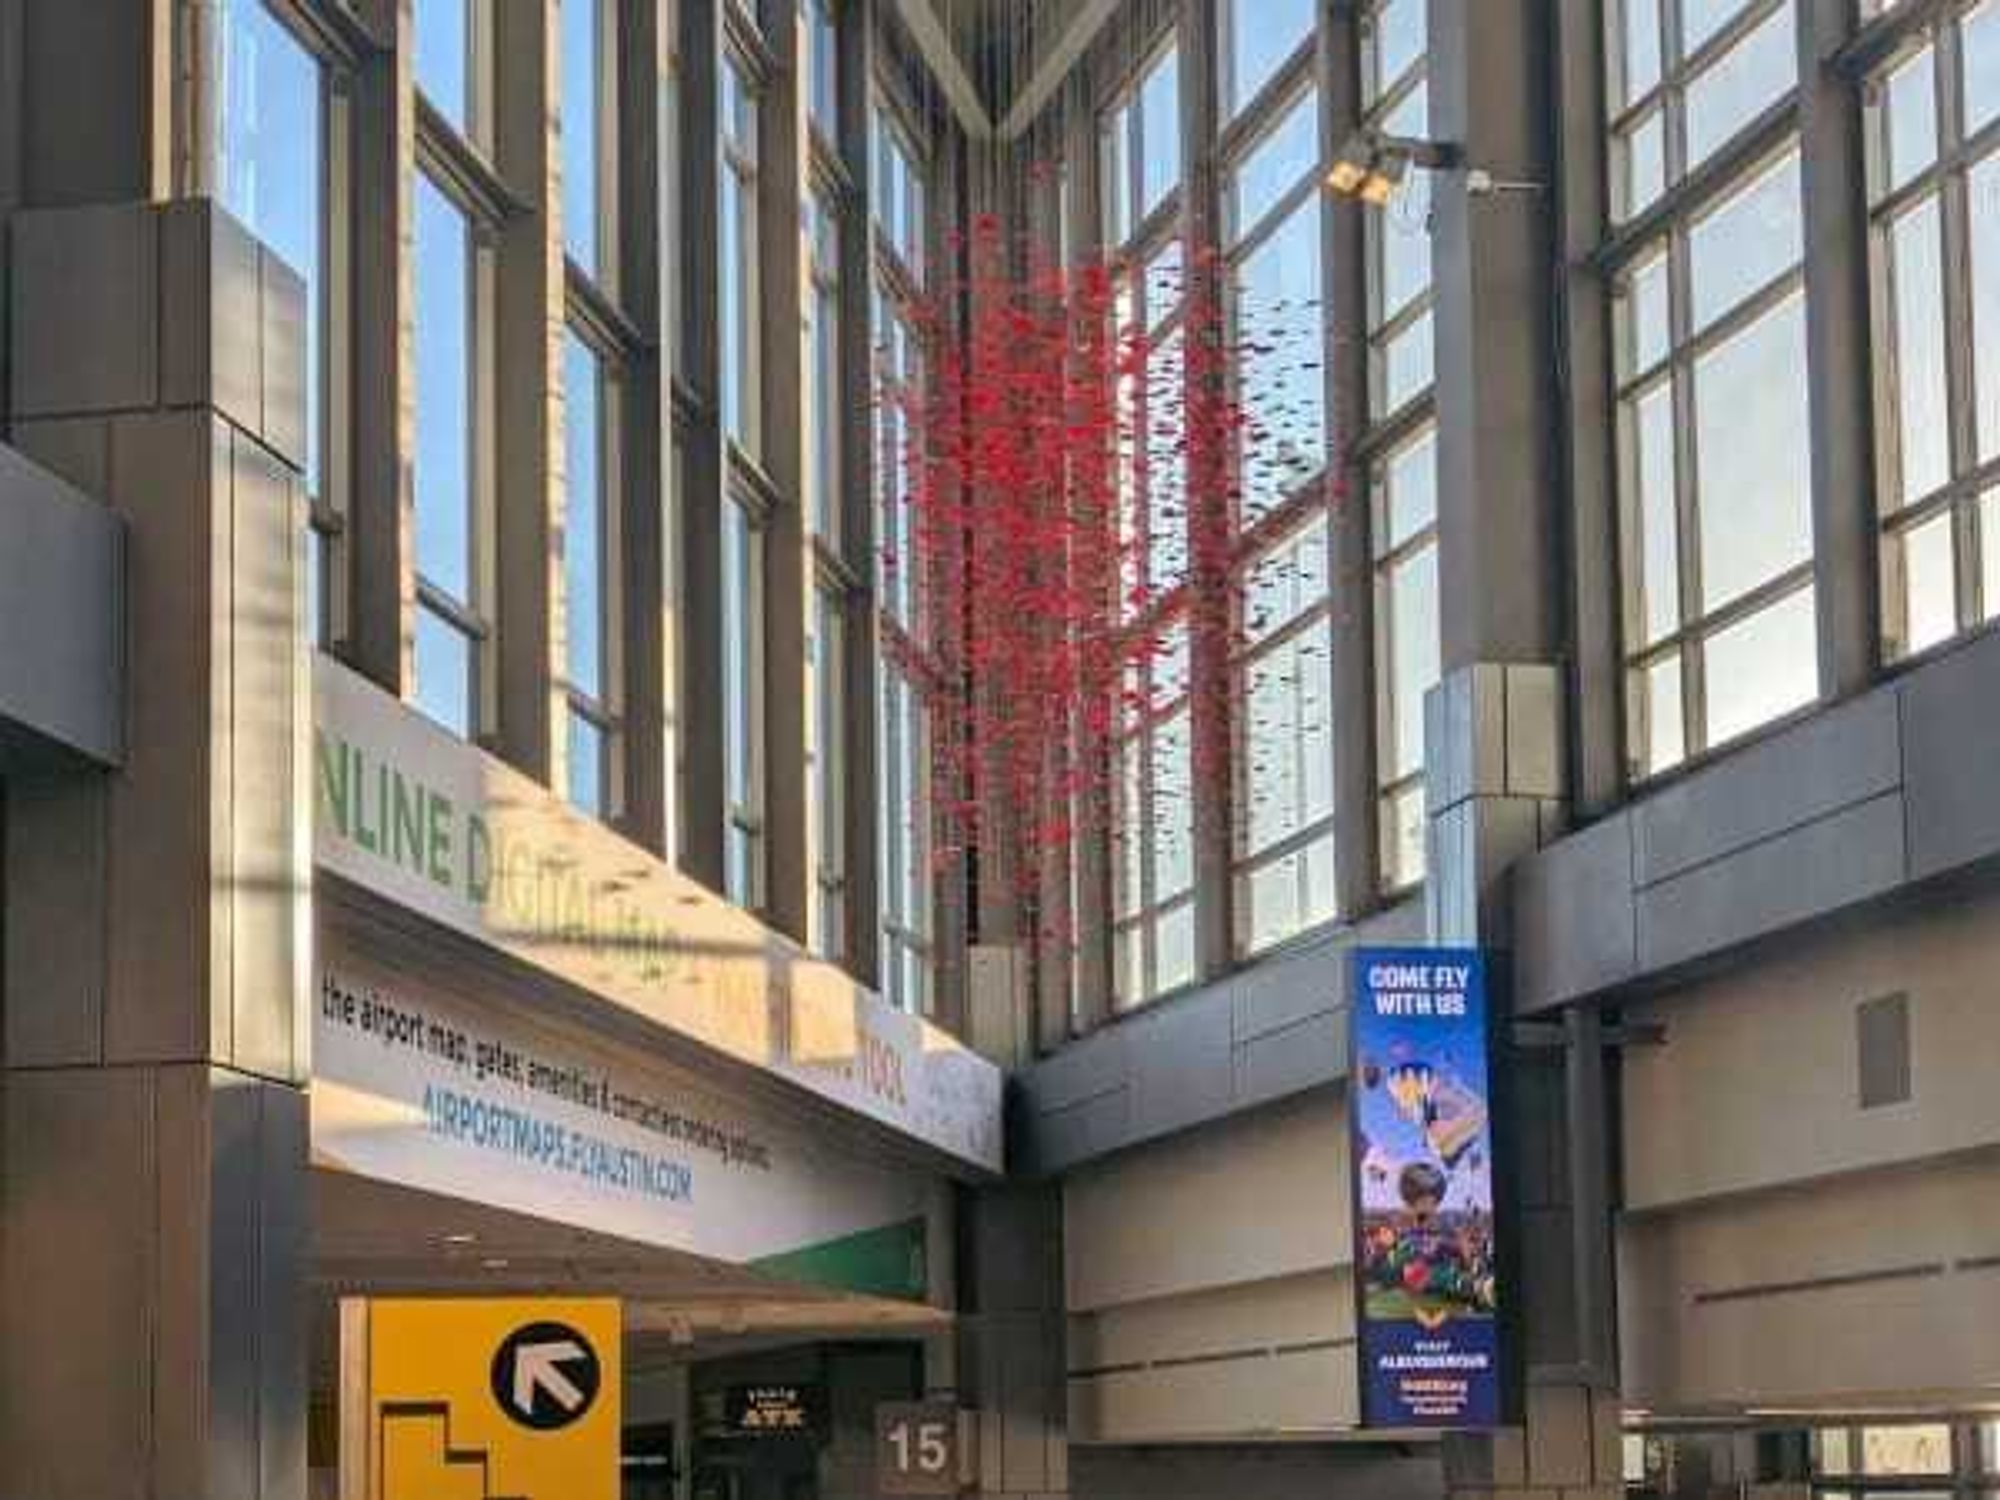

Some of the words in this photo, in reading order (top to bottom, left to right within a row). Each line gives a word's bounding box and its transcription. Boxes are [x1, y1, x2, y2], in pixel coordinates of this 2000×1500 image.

[1369, 966, 1431, 989] COME
[1436, 966, 1468, 989] FLY
[322, 970, 354, 1025] the
[360, 985, 424, 1049] airport
[1376, 993, 1432, 1015] WITH
[1437, 993, 1465, 1015] US
[888, 1423, 946, 1471] 15
